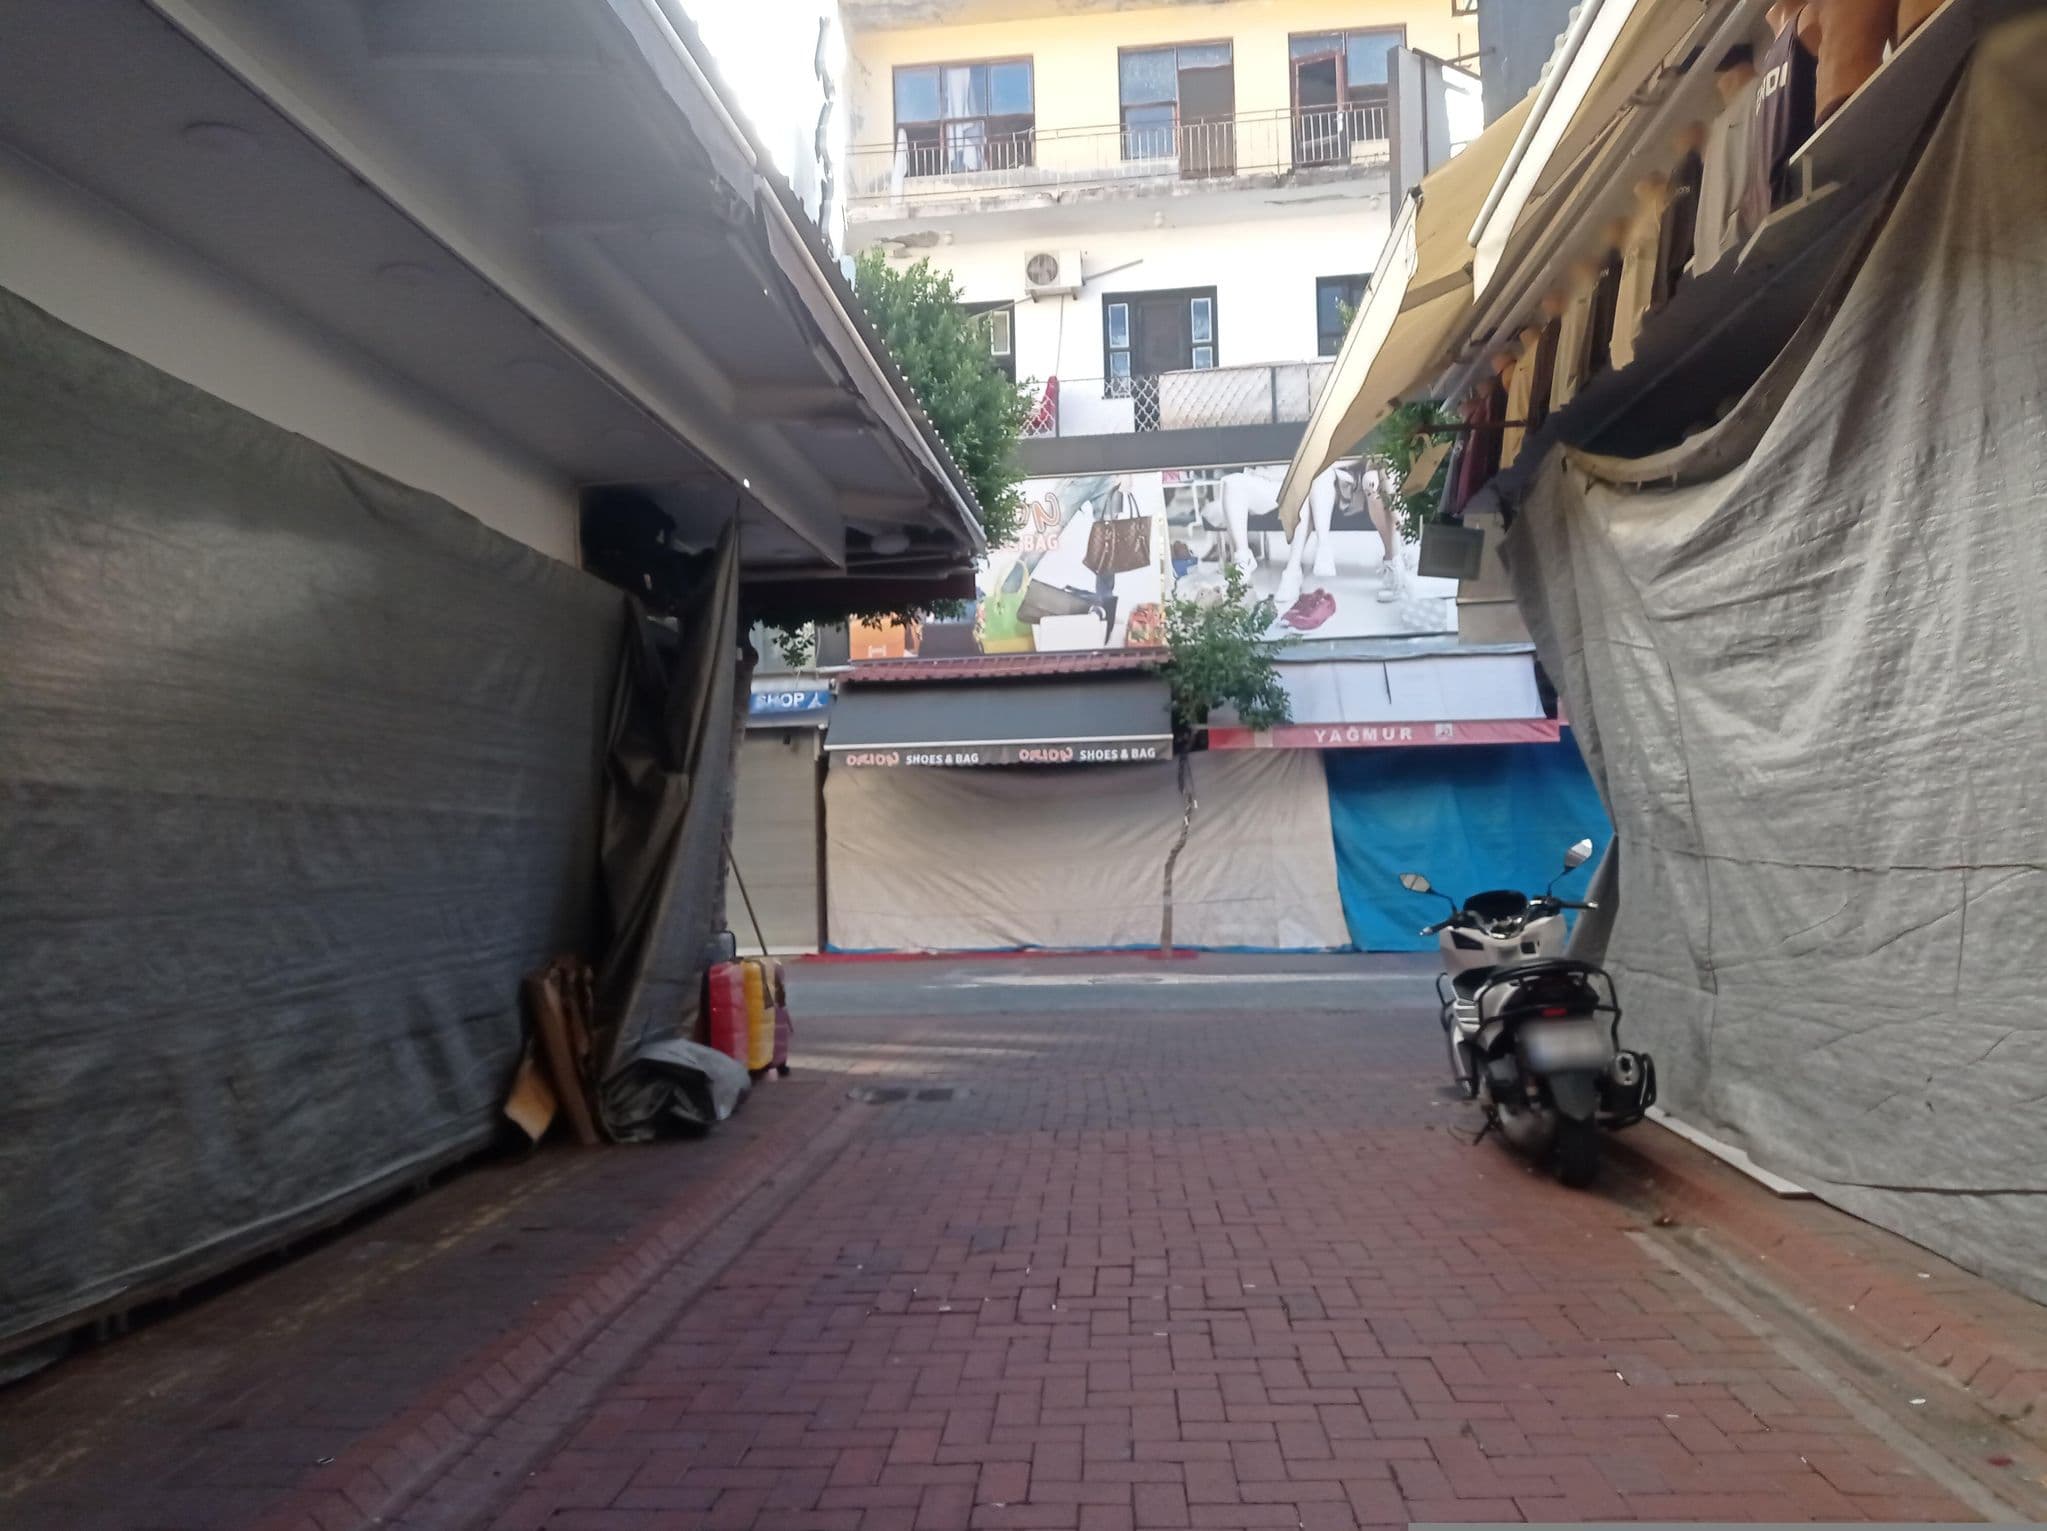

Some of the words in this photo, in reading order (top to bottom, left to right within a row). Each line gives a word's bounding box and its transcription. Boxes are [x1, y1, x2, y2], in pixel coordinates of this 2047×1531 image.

[1023, 534, 1059, 552] BAG
[906, 754, 943, 765] SHOES
[945, 753, 953, 764] &
[955, 753, 979, 764] BAG
[1080, 749, 1118, 761] SHOES
[1120, 749, 1129, 760] &
[1131, 747, 1156, 759] BAG
